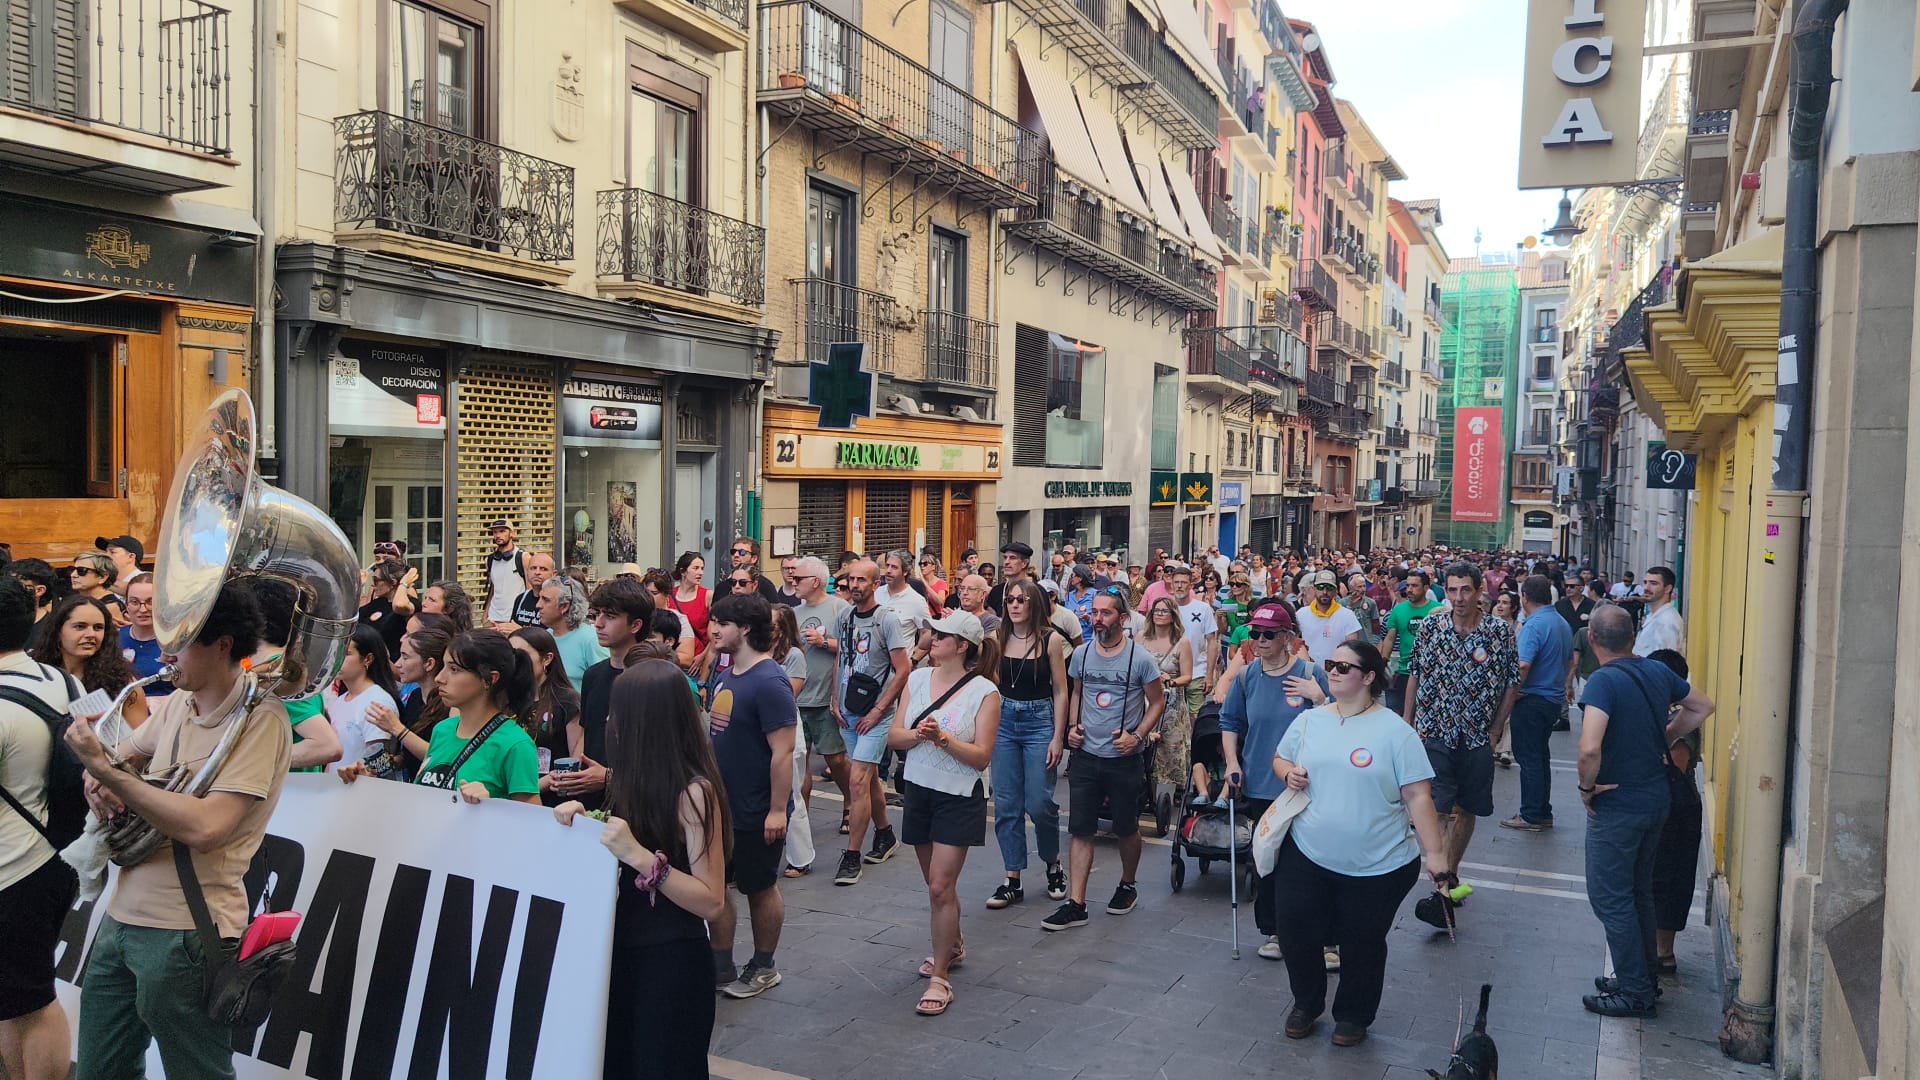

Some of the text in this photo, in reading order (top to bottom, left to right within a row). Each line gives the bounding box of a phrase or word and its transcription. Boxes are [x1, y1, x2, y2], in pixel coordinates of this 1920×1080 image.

[63, 269, 176, 291] ALKARTETXE
[563, 380, 622, 400] ALBERTO
[776, 439, 795, 463] 22
[840, 441, 921, 466] FARMACIA
[987, 451, 999, 469] 22
